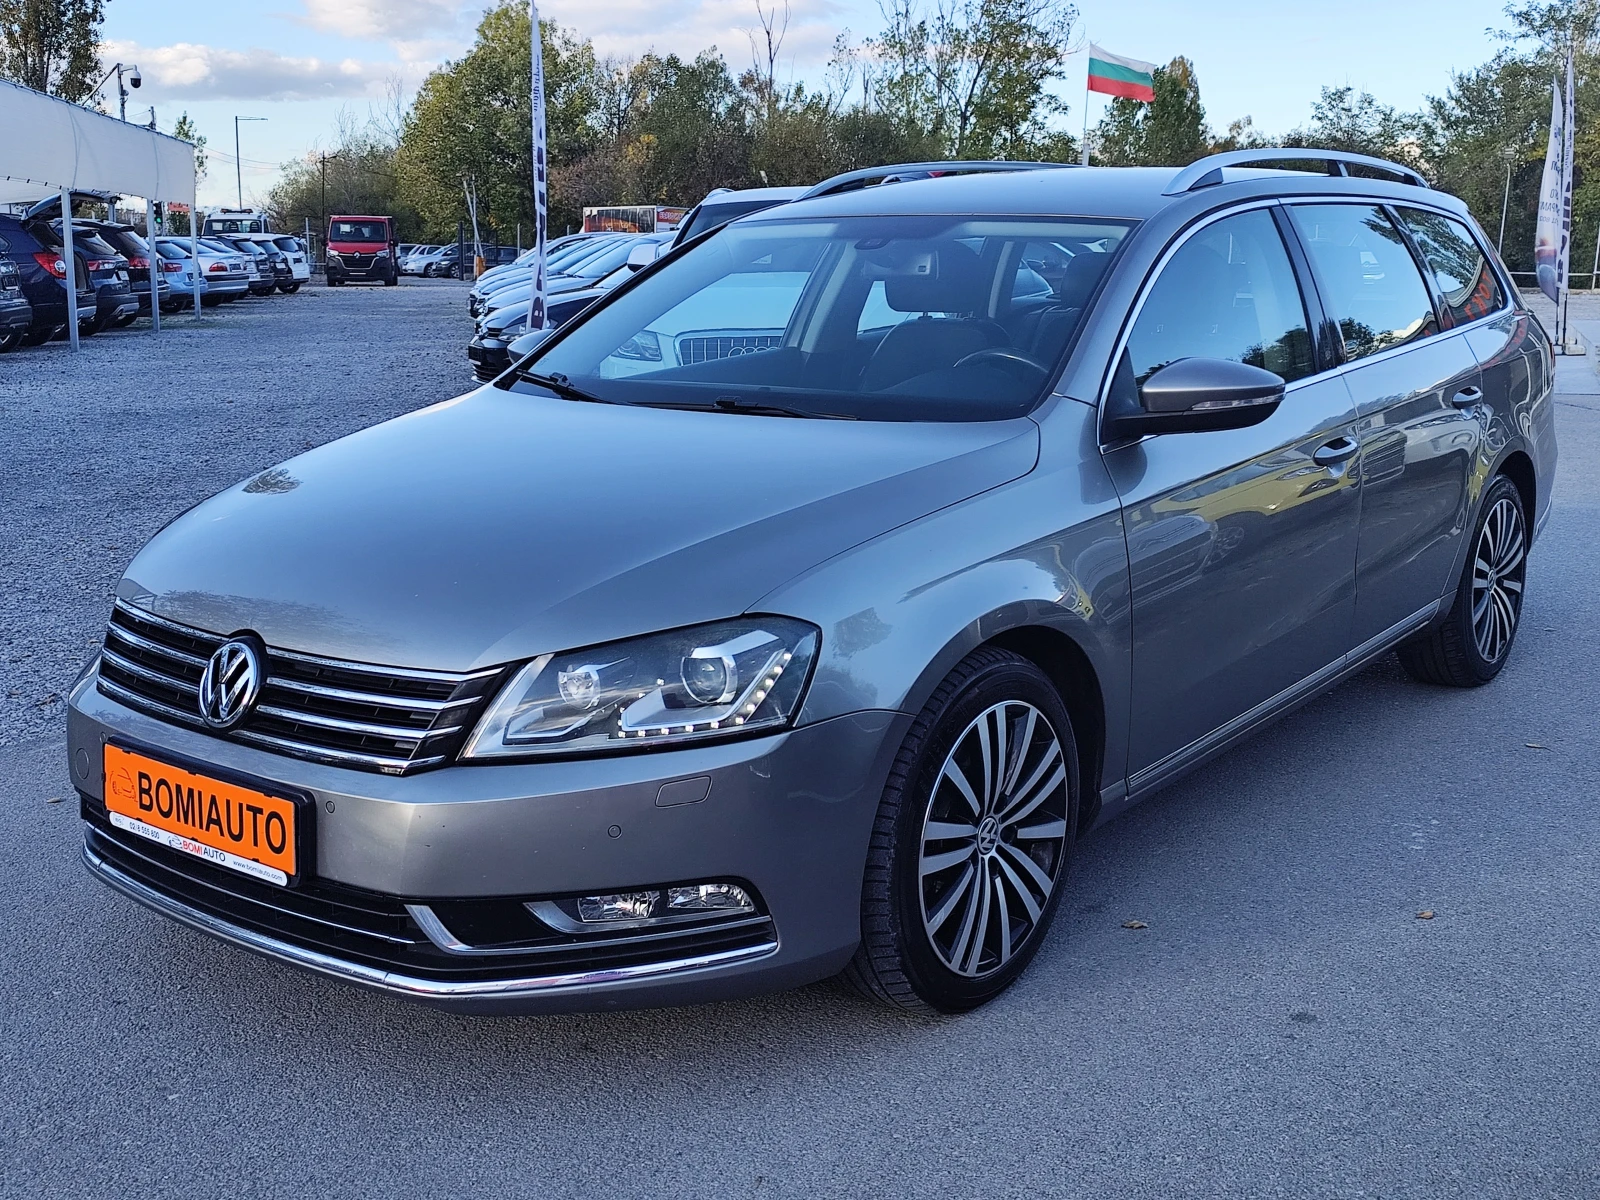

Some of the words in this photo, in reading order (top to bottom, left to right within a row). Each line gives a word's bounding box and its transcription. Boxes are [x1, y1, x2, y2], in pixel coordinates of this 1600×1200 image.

[200, 642, 258, 722] VW
[137, 771, 287, 855] BOMIAUTO
[232, 859, 283, 882] www.bomiauto.com
